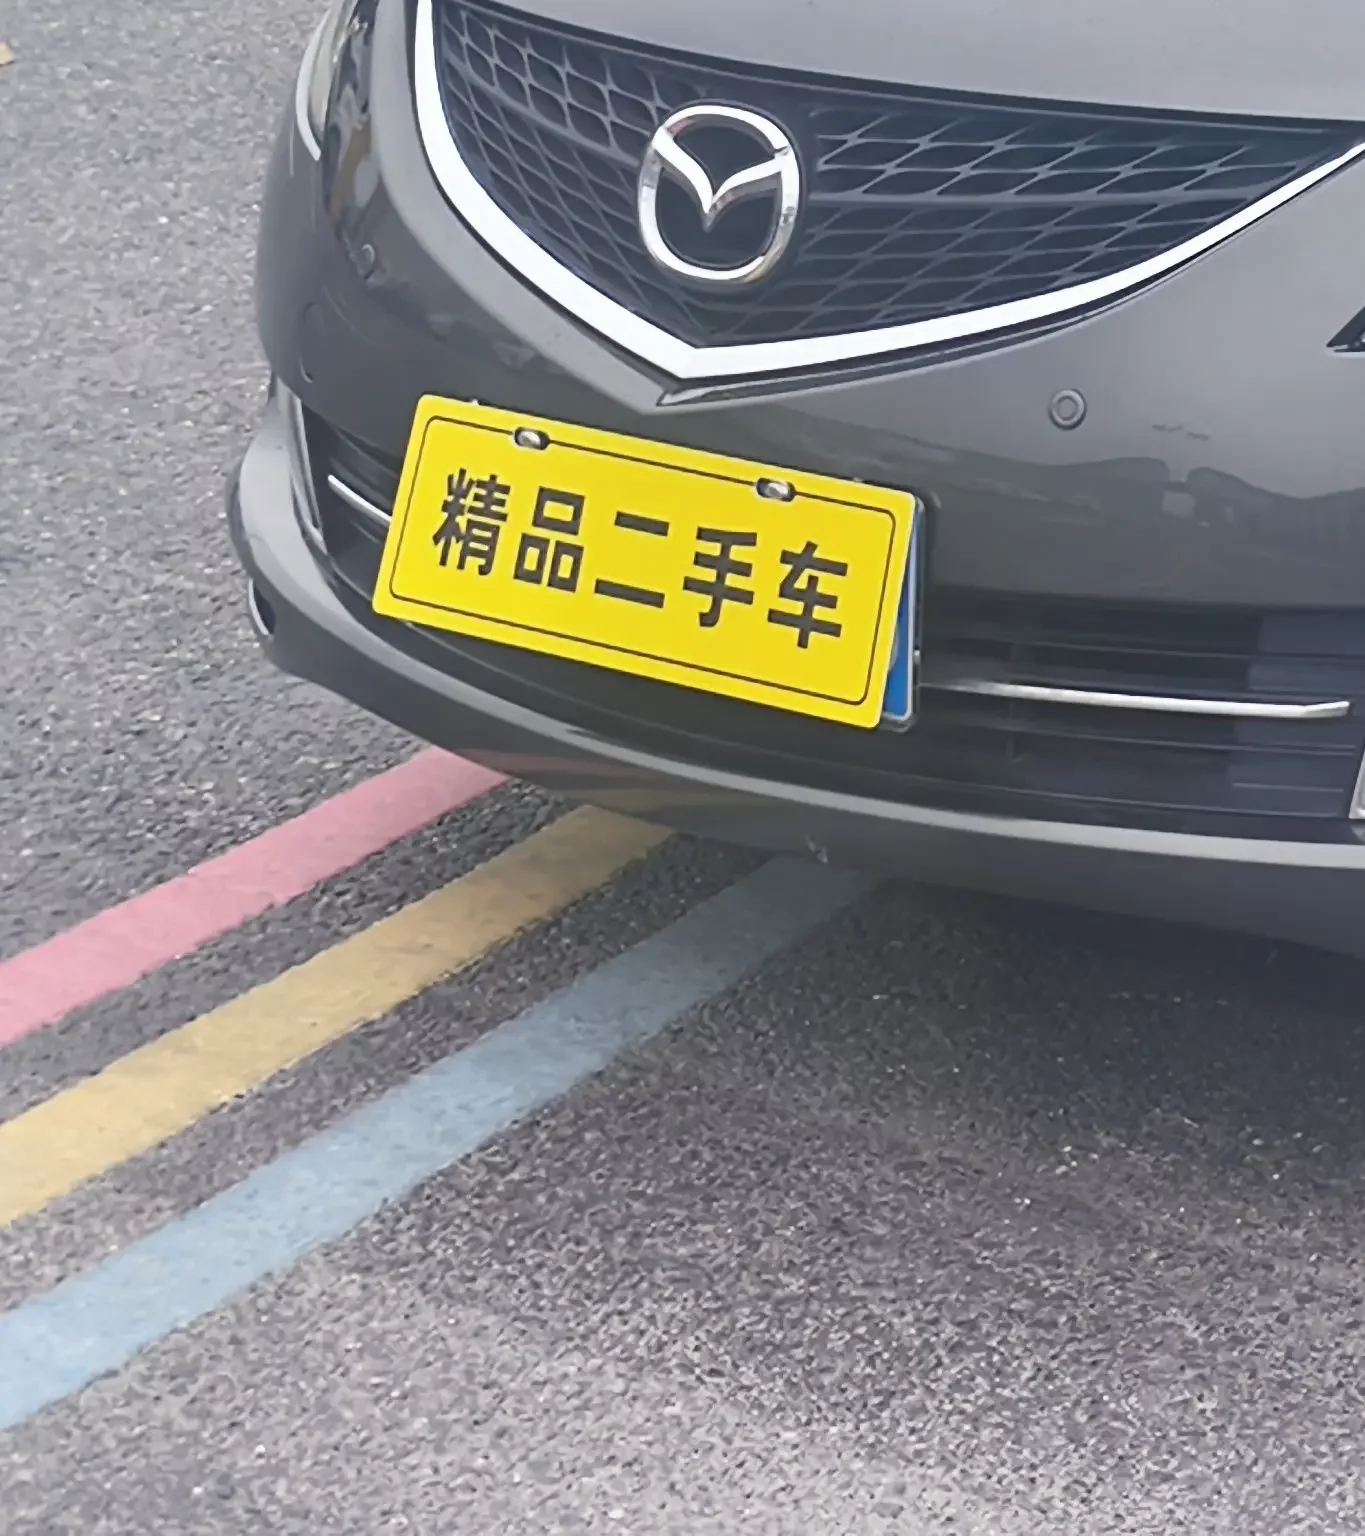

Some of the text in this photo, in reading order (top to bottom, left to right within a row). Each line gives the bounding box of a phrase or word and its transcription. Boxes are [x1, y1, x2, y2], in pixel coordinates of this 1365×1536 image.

[432, 467, 849, 649] 精品二手车
